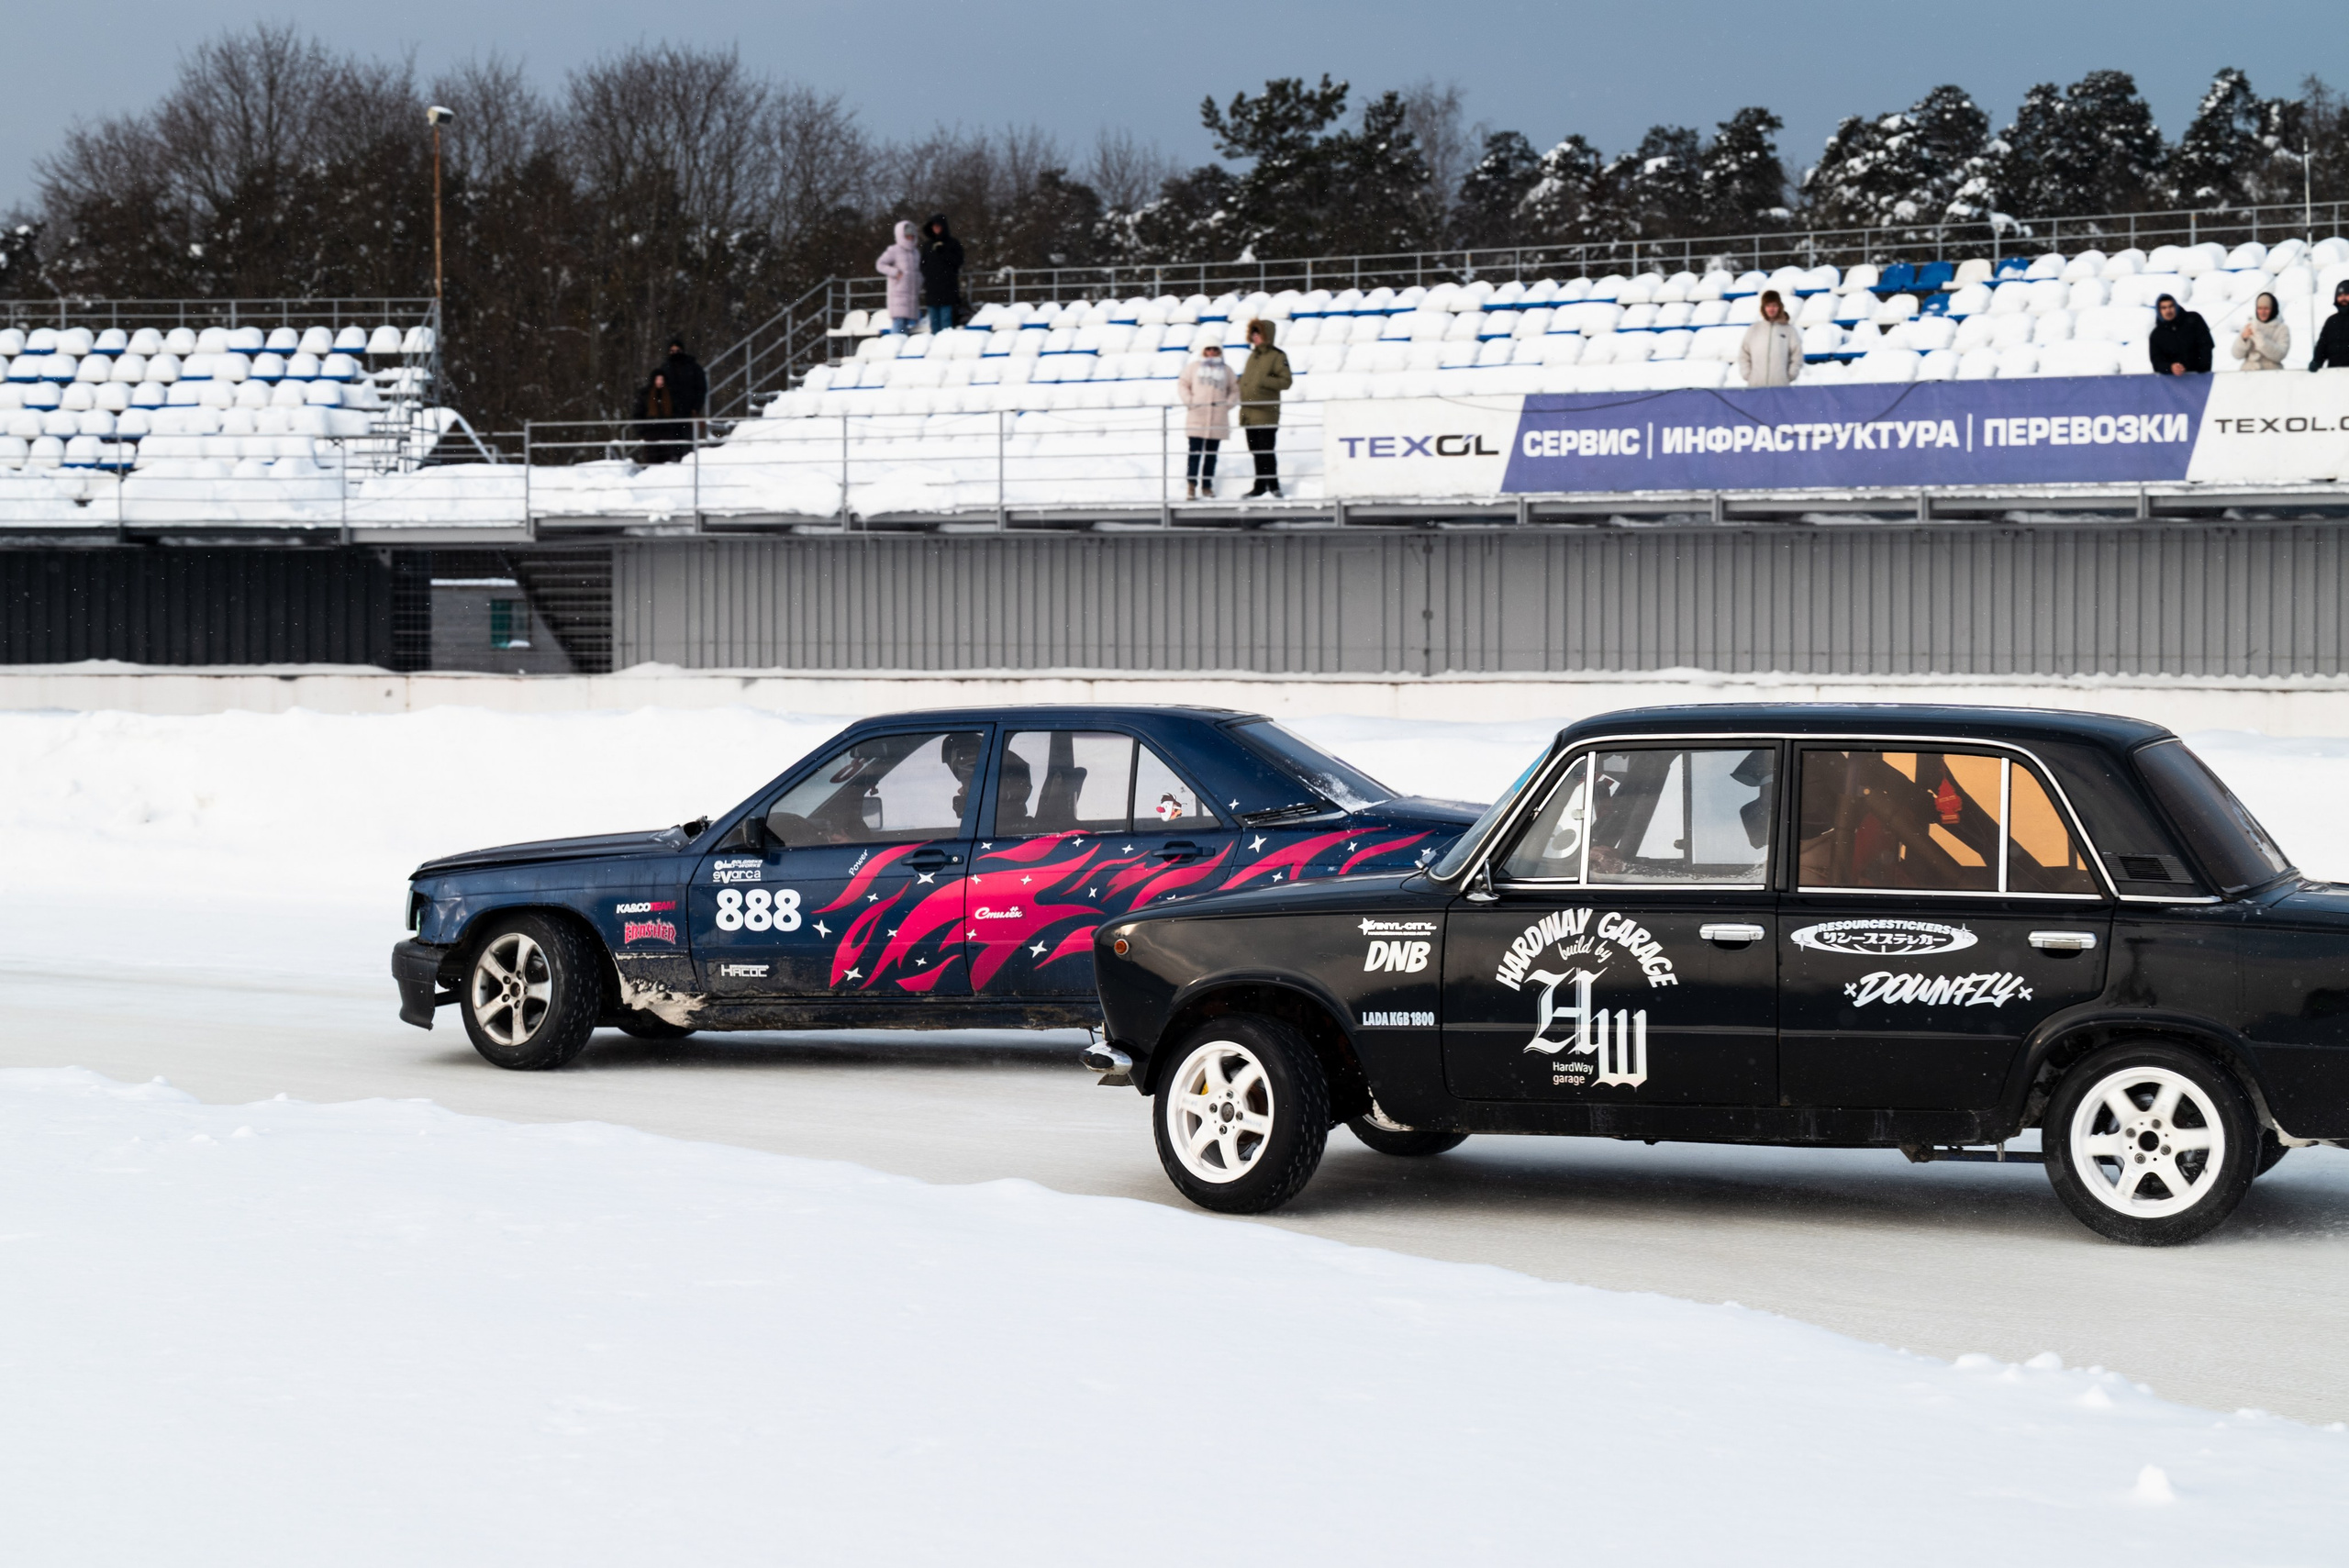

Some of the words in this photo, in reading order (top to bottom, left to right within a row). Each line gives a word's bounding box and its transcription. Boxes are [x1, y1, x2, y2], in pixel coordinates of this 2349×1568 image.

[1338, 433, 1499, 458] TEXOL
[1522, 428, 1641, 458] СЕРВИС
[1662, 418, 1960, 454] ИНФРАСТРУКТУРА
[1984, 413, 2188, 448] ПЕРЕВОЗКИ
[848, 849, 868, 876] Power
[716, 888, 802, 932] 888
[1818, 919, 1952, 935] RESOURCESTICKERS
[1364, 940, 1431, 973] DNB
[1496, 907, 1593, 991] HARDWAY
[1598, 912, 1678, 988] GARAGE
[1558, 935, 1595, 961] build
[1595, 940, 1612, 963] by
[1853, 971, 2024, 1007] DOWNFLY
[1363, 1011, 1389, 1026] LADA
[1389, 1011, 1409, 1026] KGB
[1410, 1011, 1434, 1026] 1800
[1553, 1062, 1594, 1074] HardWay
[1553, 1074, 1586, 1085] garage
